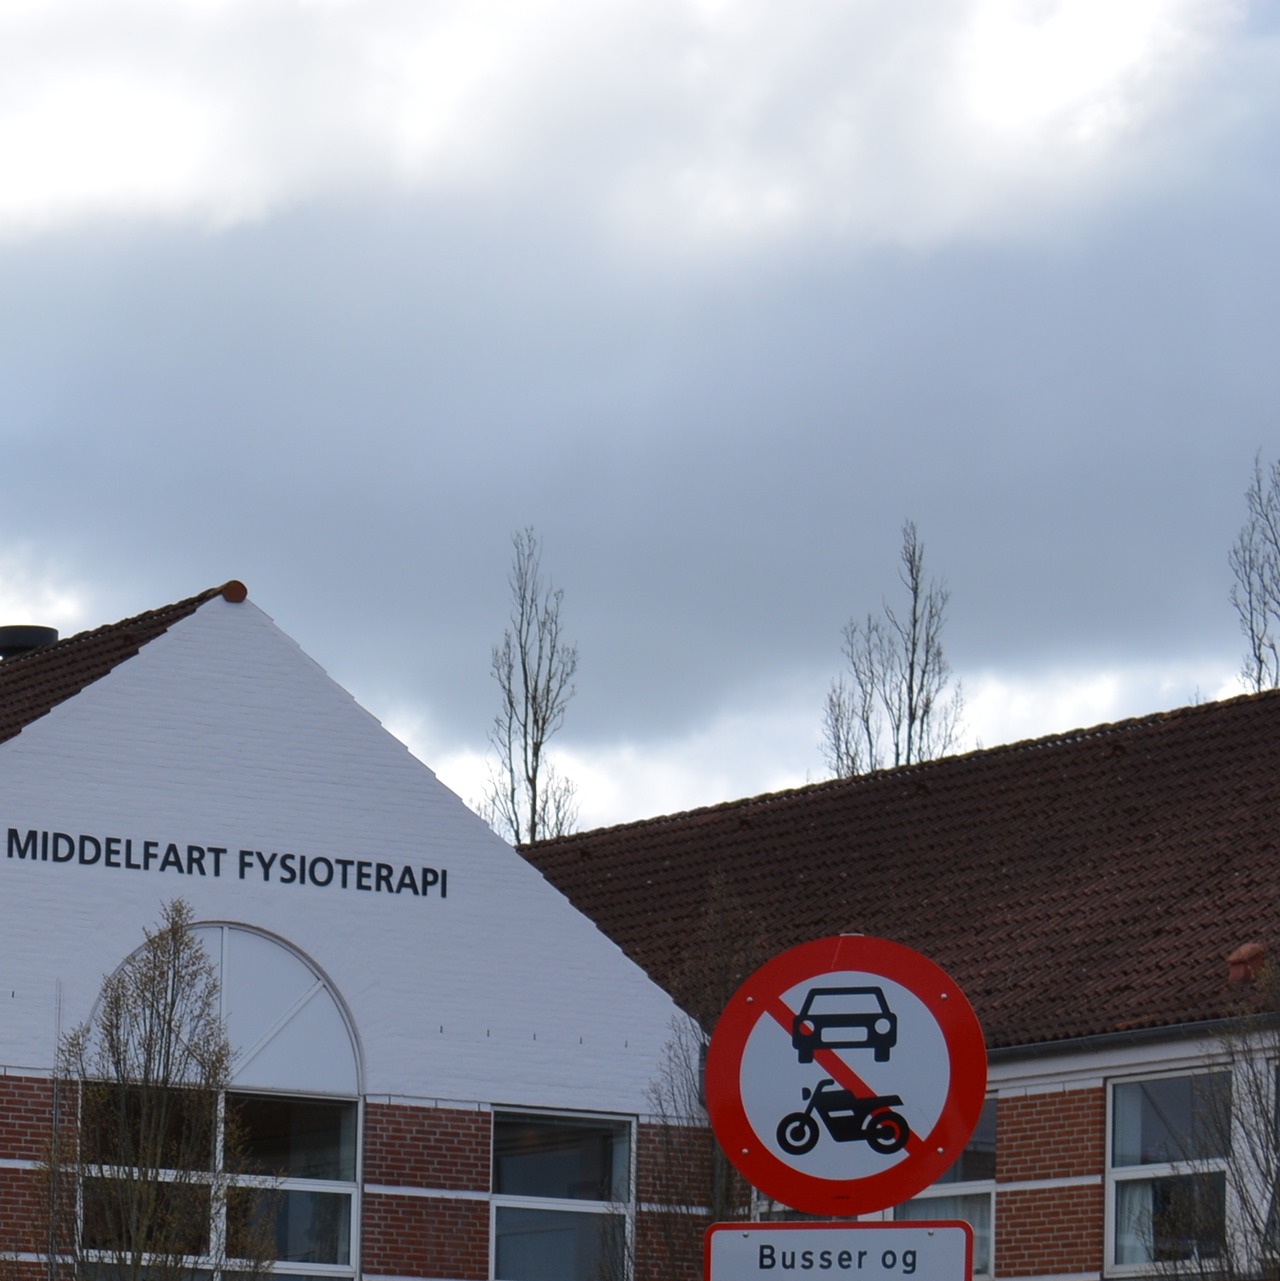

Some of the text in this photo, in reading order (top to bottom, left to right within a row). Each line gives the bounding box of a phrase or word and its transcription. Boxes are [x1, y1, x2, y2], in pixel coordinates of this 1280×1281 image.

[6, 828, 448, 898] MIDDELFART FYSIOTERAPI
[758, 1244, 917, 1275] Busser og
